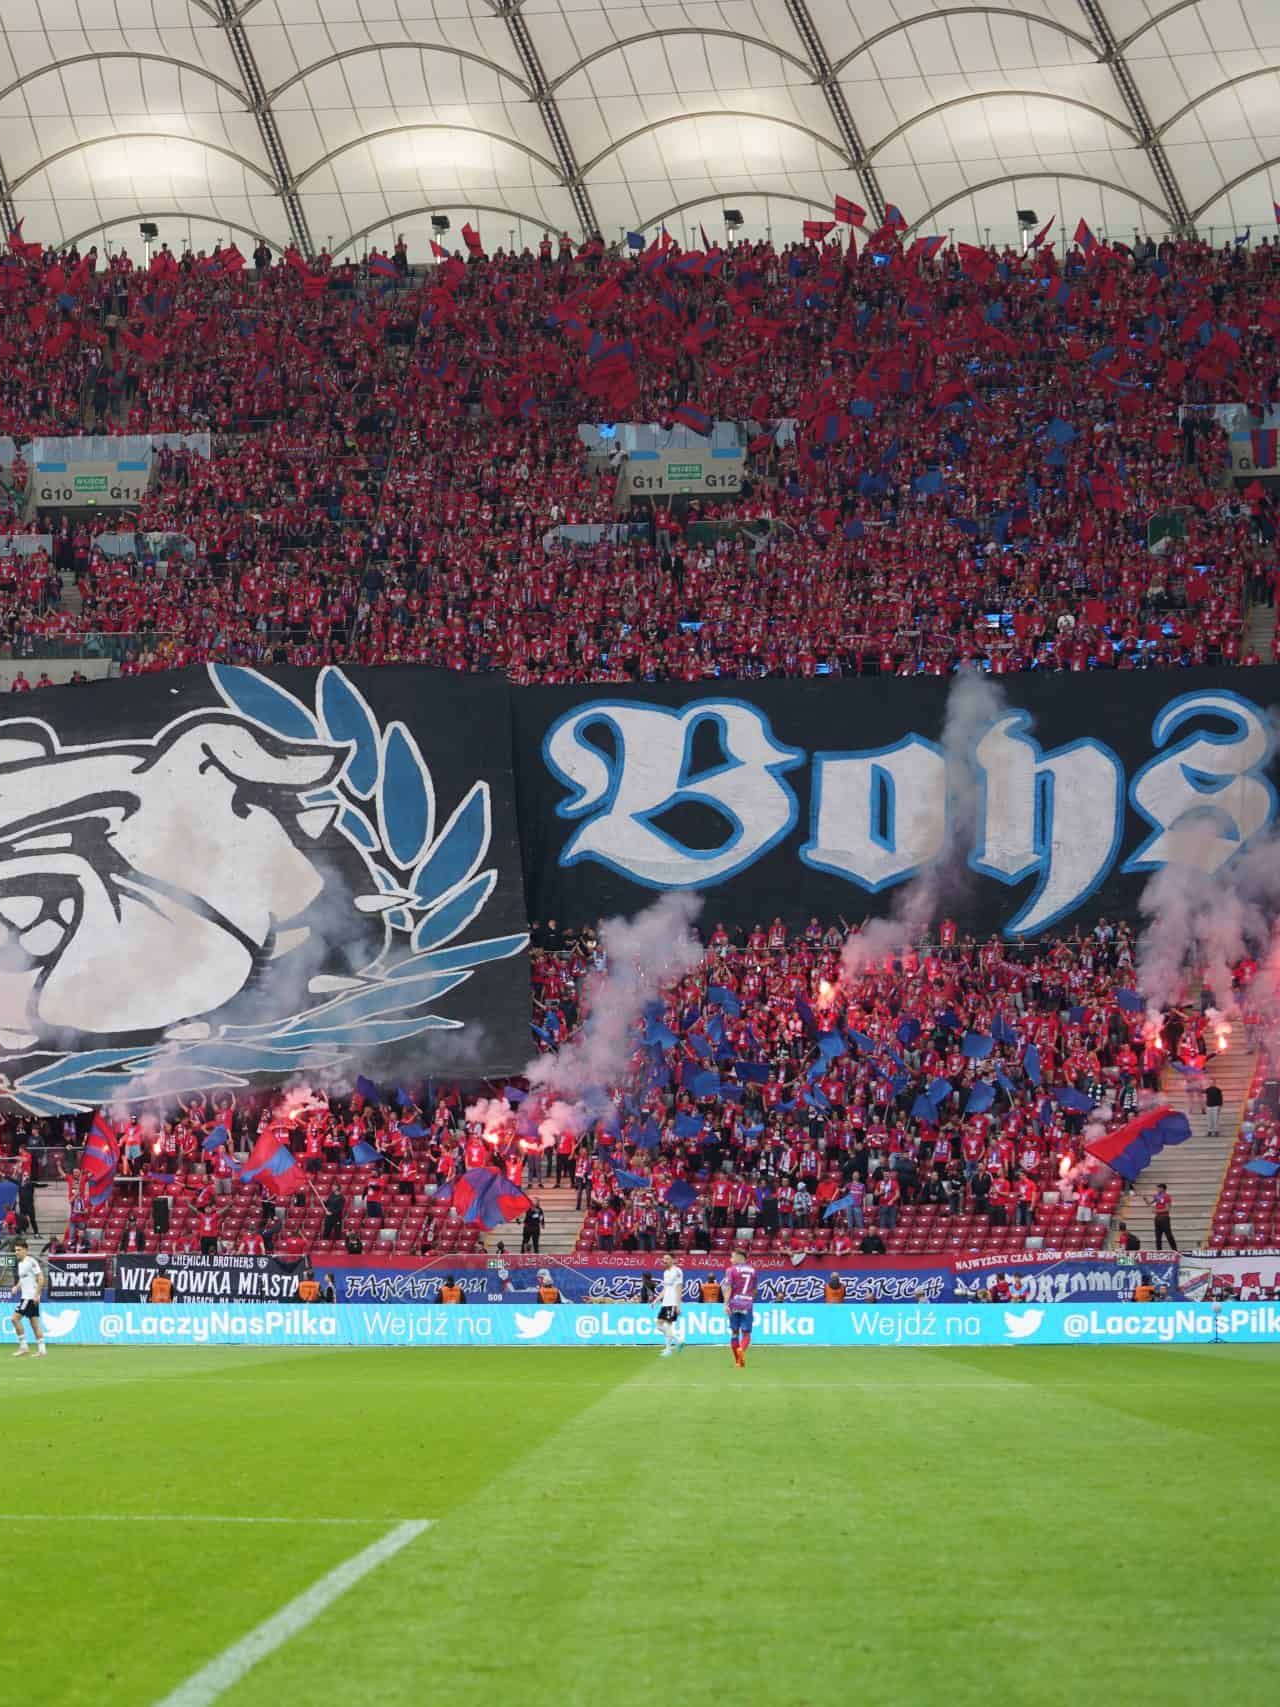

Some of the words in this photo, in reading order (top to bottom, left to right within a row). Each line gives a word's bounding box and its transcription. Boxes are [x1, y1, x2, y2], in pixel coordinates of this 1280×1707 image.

[633, 476, 663, 489] G11
[705, 475, 737, 487] G12
[41, 488, 72, 500] G10
[110, 488, 140, 500] G11
[542, 689, 1279, 936] Boys
[171, 1255, 211, 1267] CHEMICAL
[213, 1255, 254, 1269] BROTHERS
[238, 1271, 301, 1297] MIASTA
[741, 1274, 751, 1295] 7
[759, 1275, 944, 1301] NIEBESKICH
[99, 1310, 336, 1340] @LaczyNasPilka
[364, 1311, 449, 1340] Wejdź
[458, 1317, 491, 1335] na
[851, 1310, 937, 1340] Wejdź
[946, 1316, 980, 1335] na
